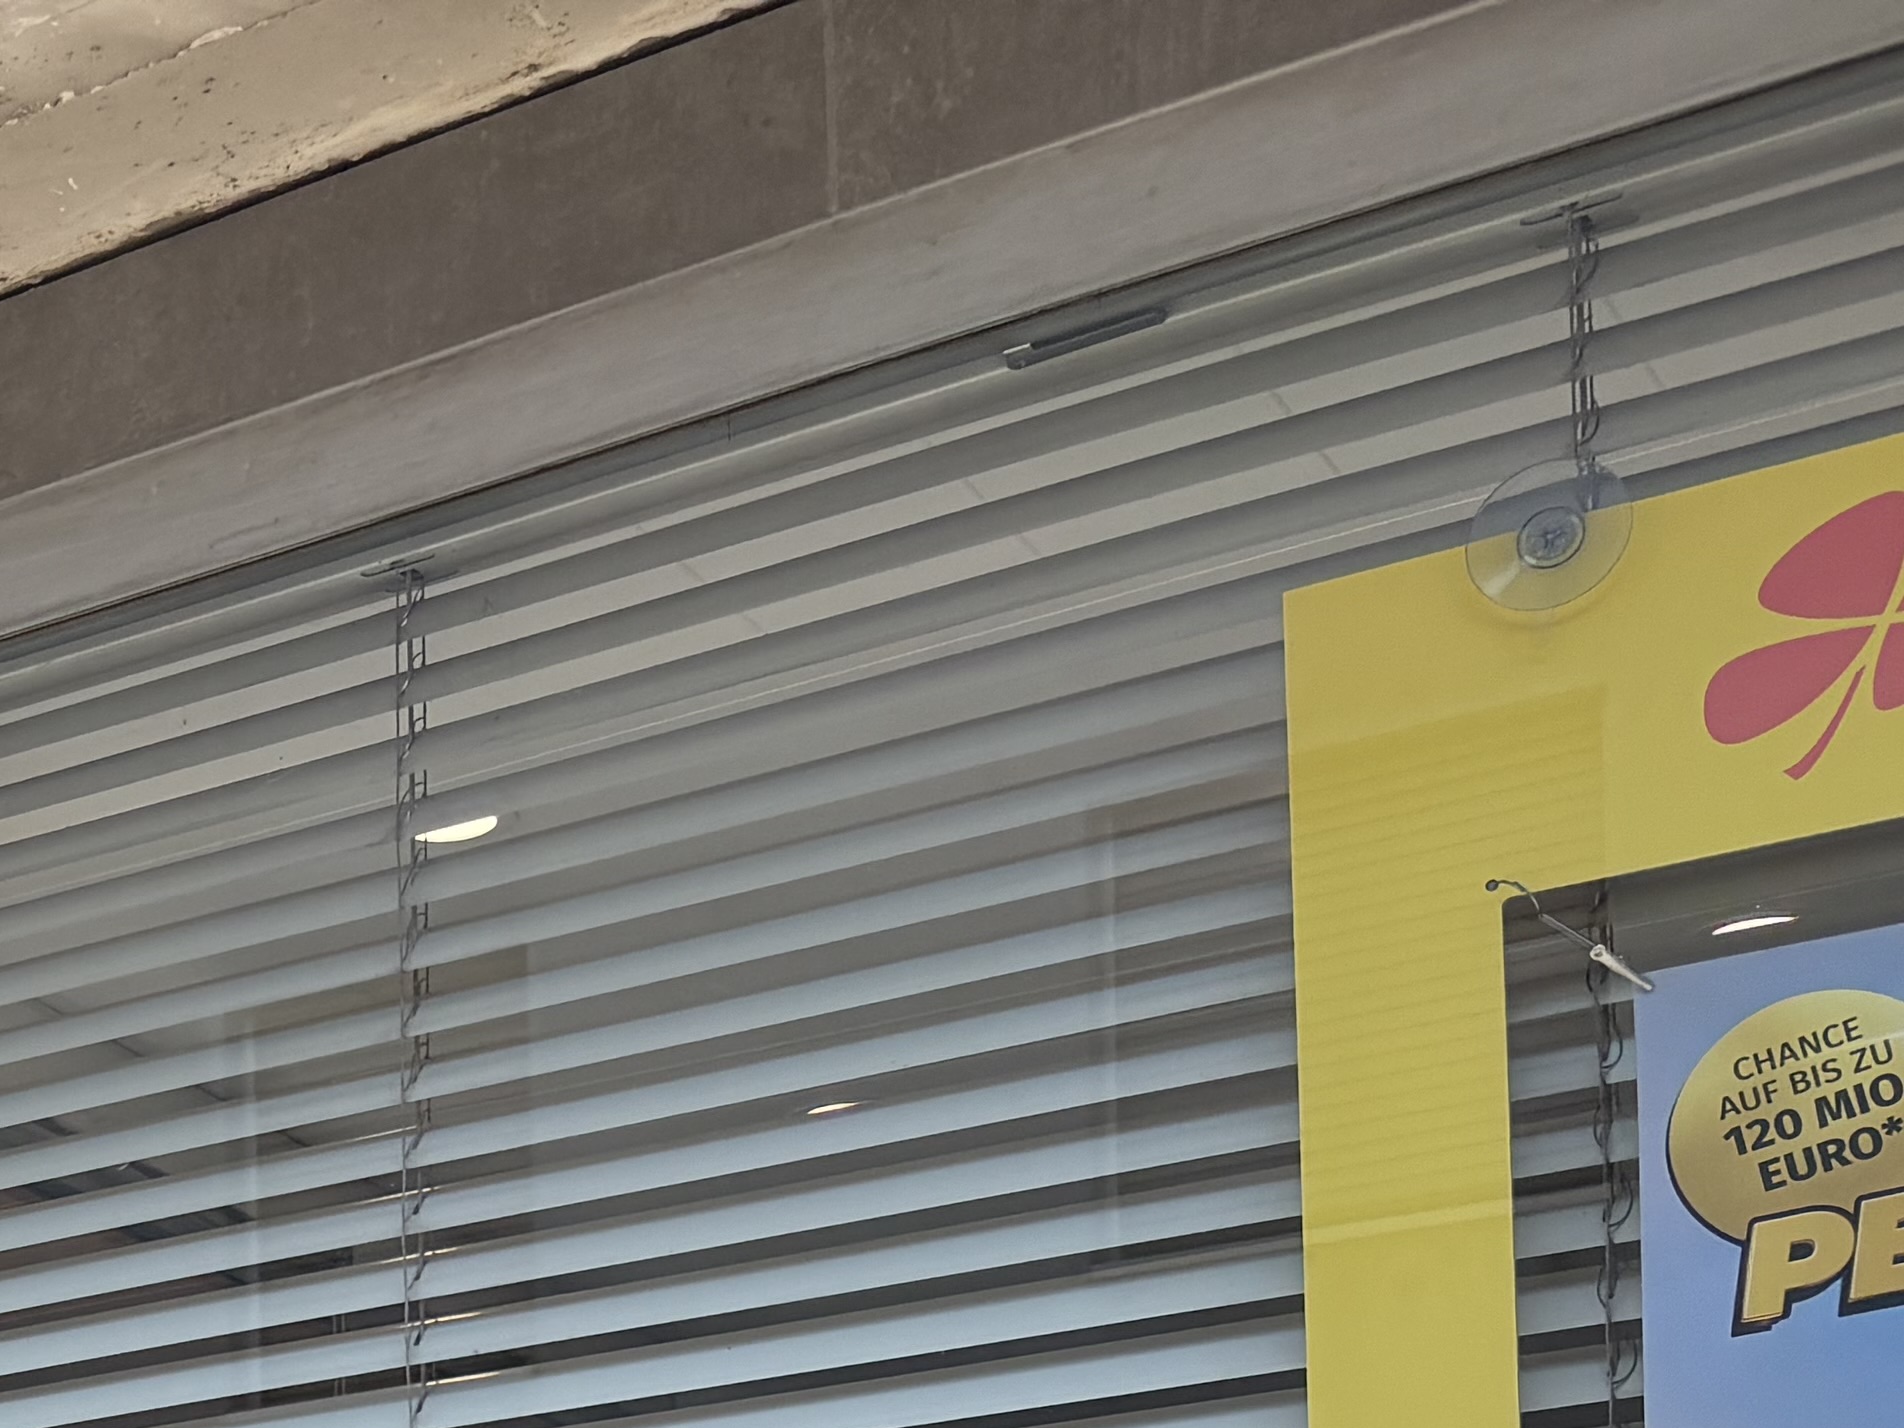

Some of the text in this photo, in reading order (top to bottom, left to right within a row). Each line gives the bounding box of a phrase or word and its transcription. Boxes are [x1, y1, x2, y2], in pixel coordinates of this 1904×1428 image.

[1719, 1039, 1894, 1121] AUF BIS ZU
[1732, 1016, 1864, 1082] CHANCE
[1723, 1113, 1804, 1157] 120
